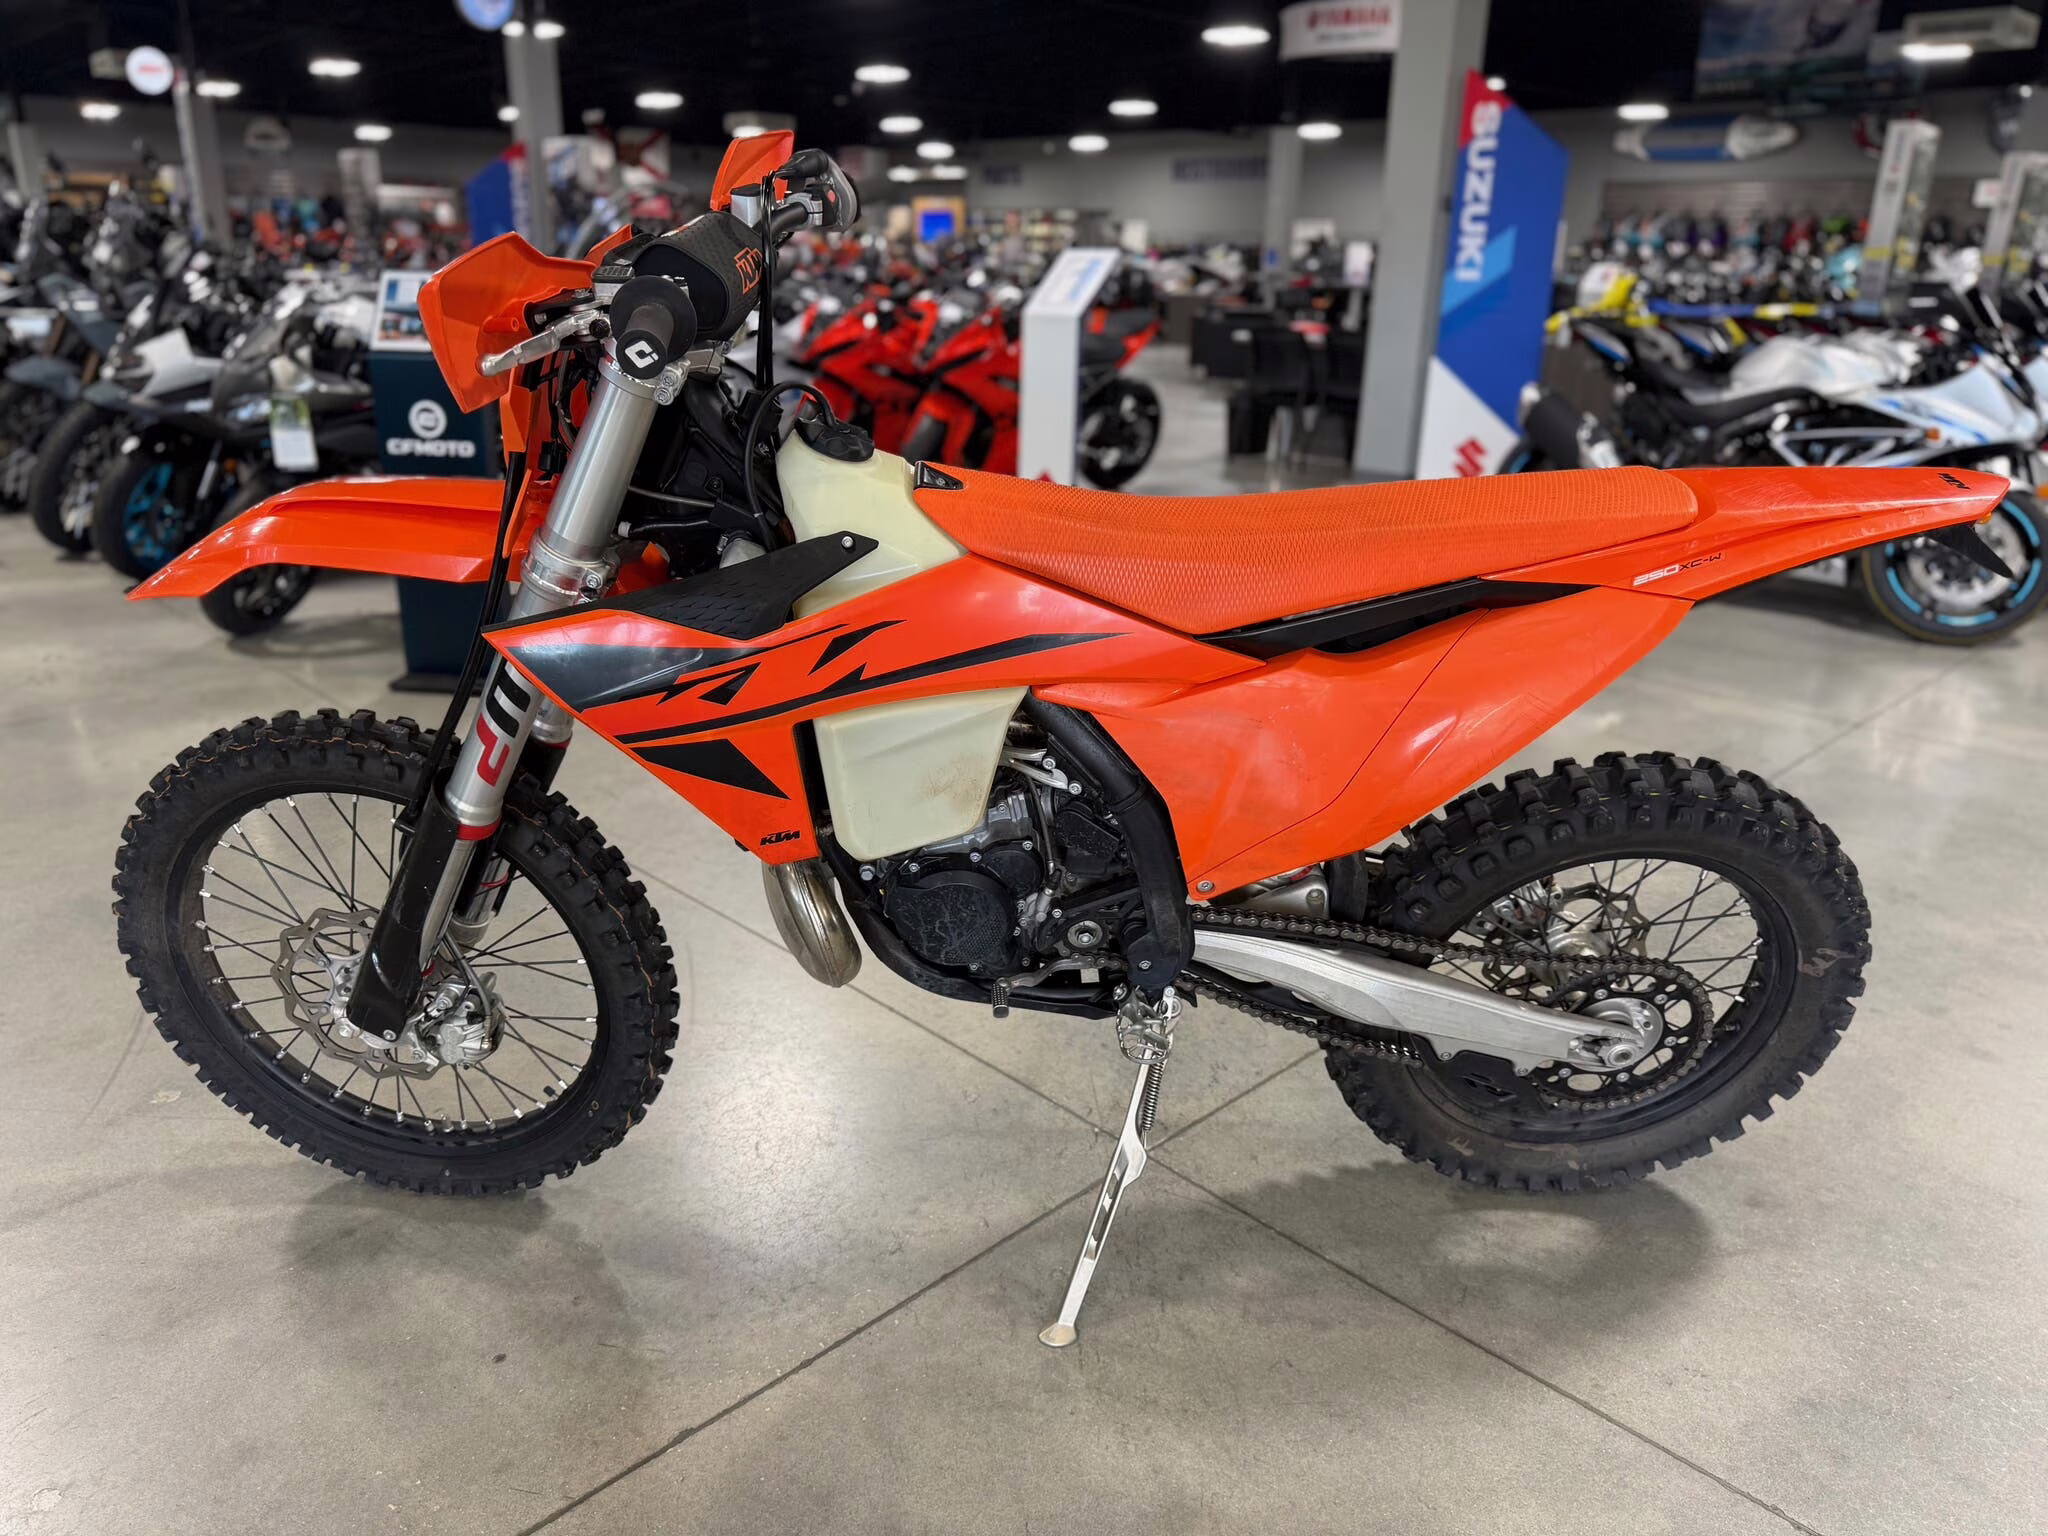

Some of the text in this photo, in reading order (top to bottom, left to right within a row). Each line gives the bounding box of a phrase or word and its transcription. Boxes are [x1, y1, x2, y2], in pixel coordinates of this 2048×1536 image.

[1455, 100, 1502, 281] SUZUKI
[385, 437, 475, 458] CFMOTO
[760, 829, 800, 846] KTM
